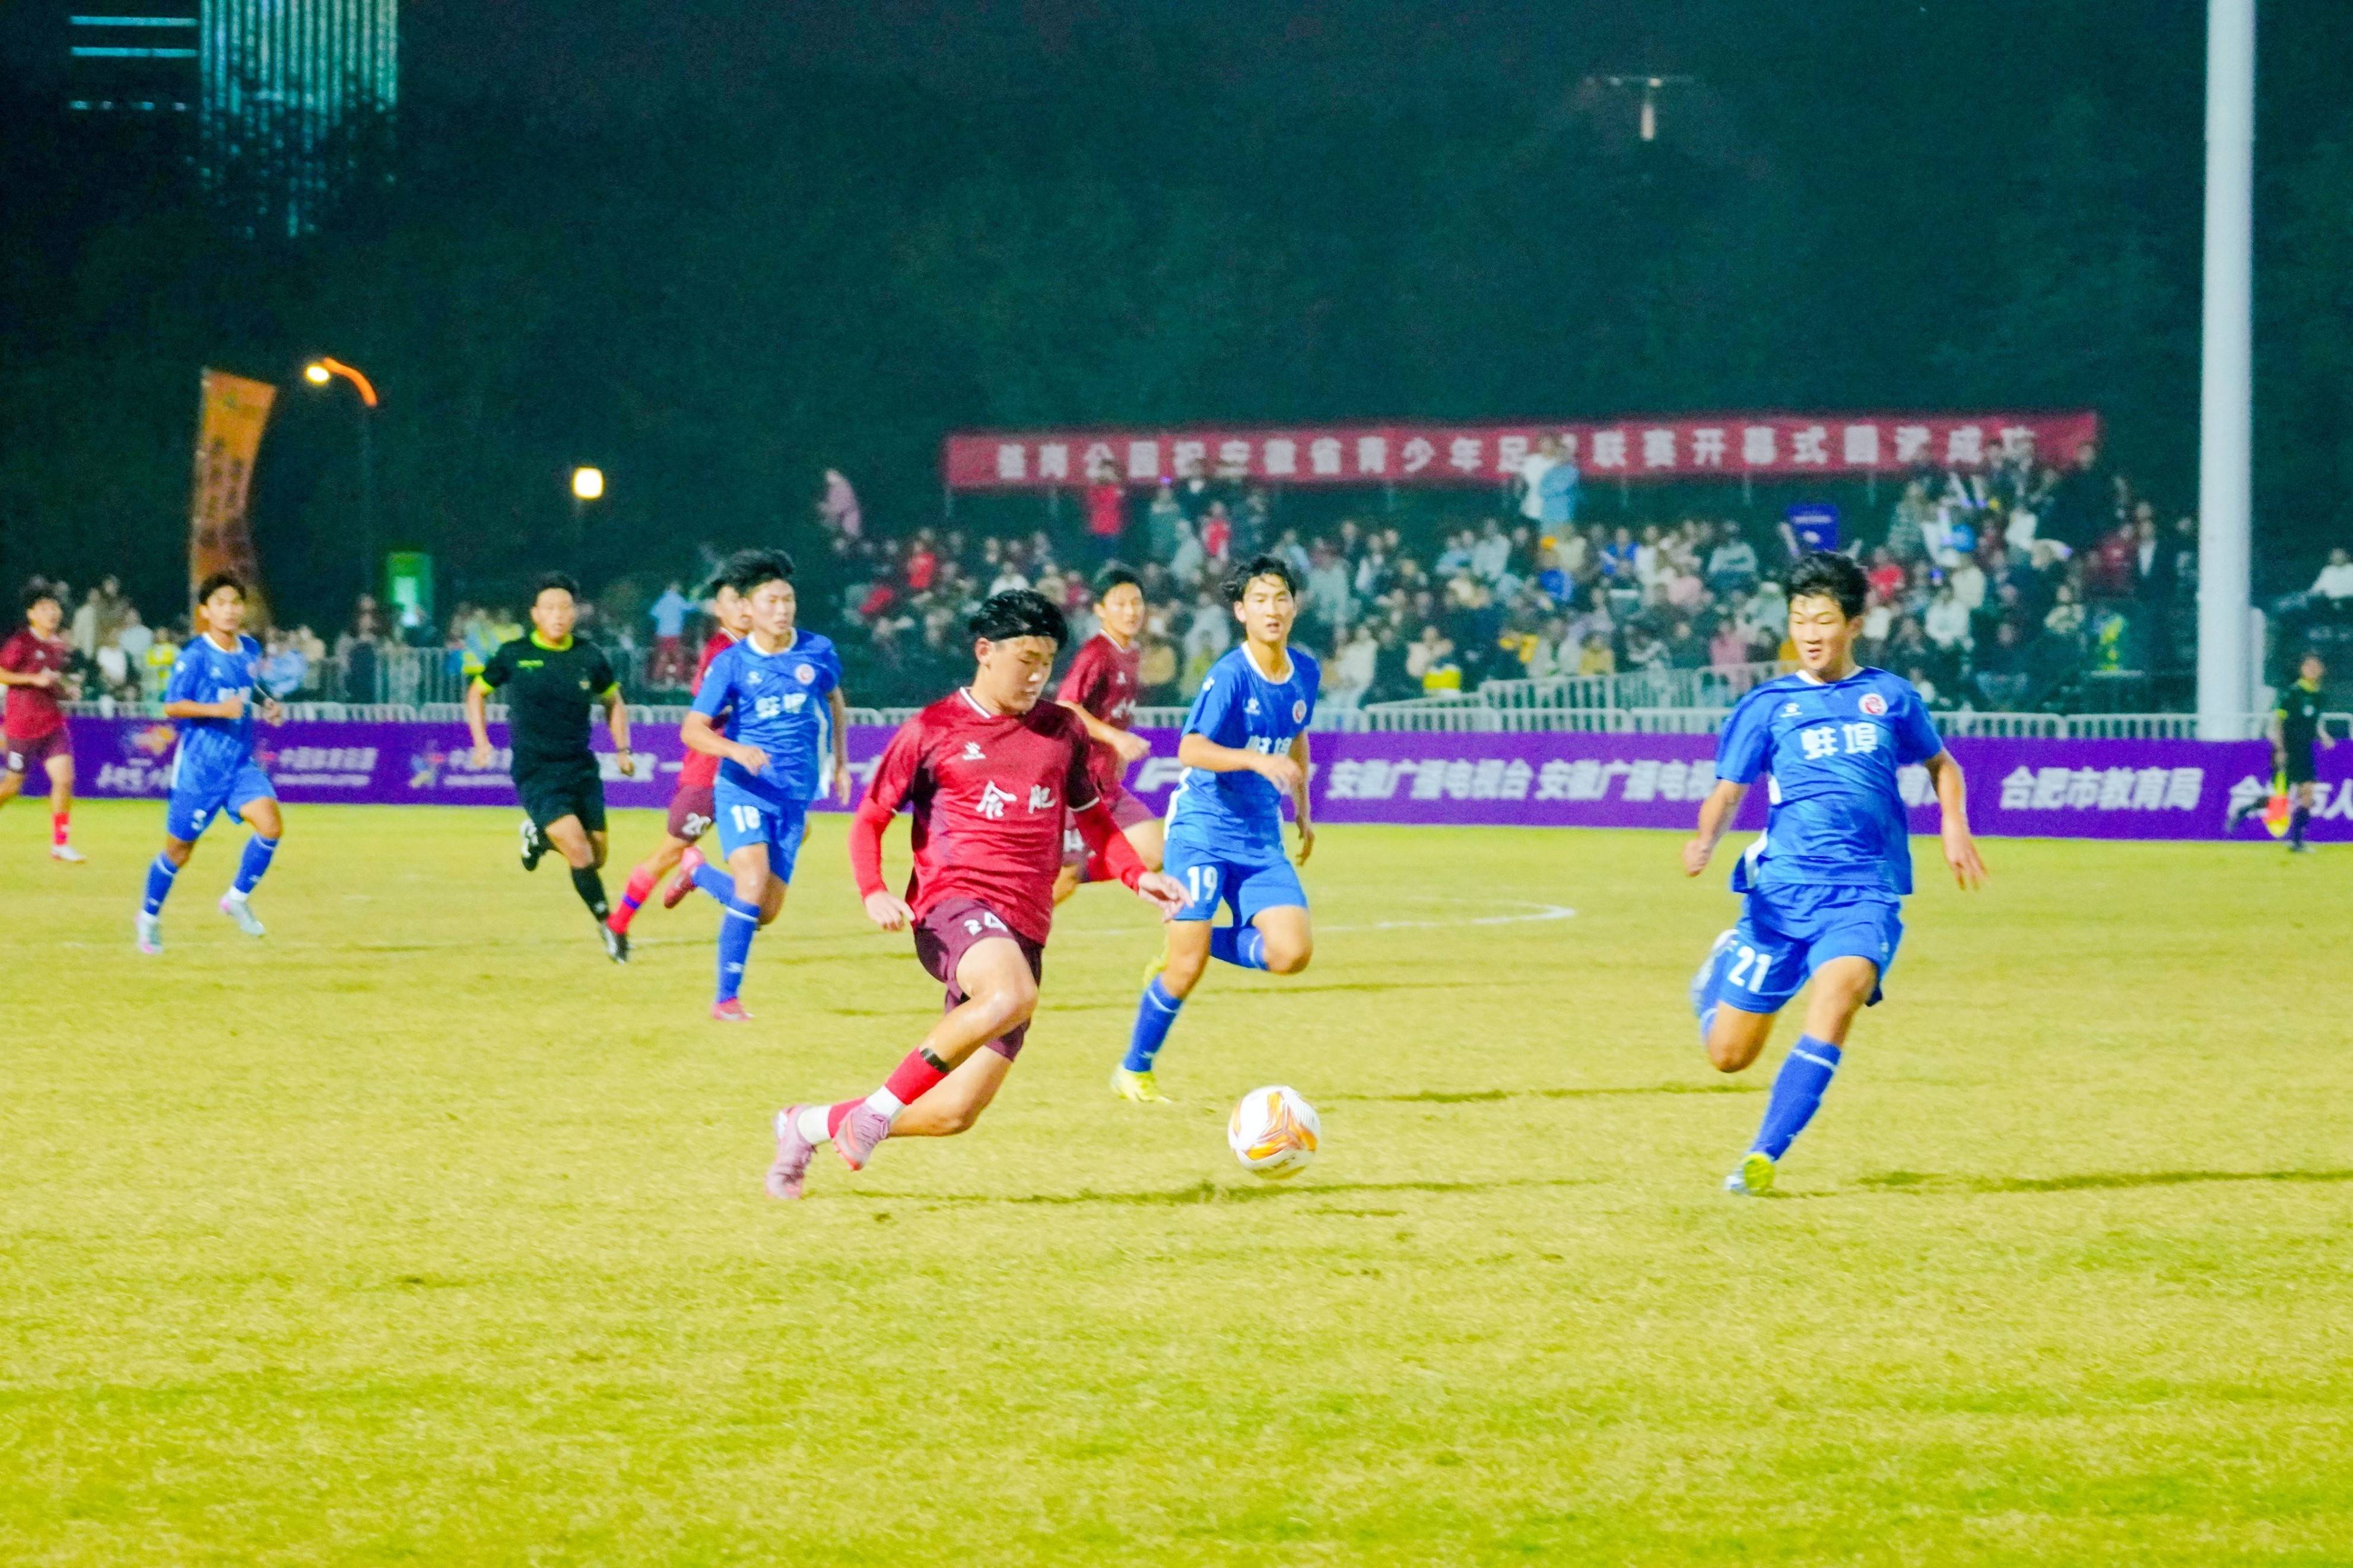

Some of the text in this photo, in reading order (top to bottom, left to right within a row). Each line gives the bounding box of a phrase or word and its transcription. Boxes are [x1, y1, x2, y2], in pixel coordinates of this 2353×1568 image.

[1801, 722, 1878, 759] 蚌埠
[1326, 758, 1533, 800] 安徽广播电视台
[1999, 765, 2204, 811] 合肥市教育局
[1187, 866, 1218, 901] 19
[1728, 946, 1773, 994] 21
